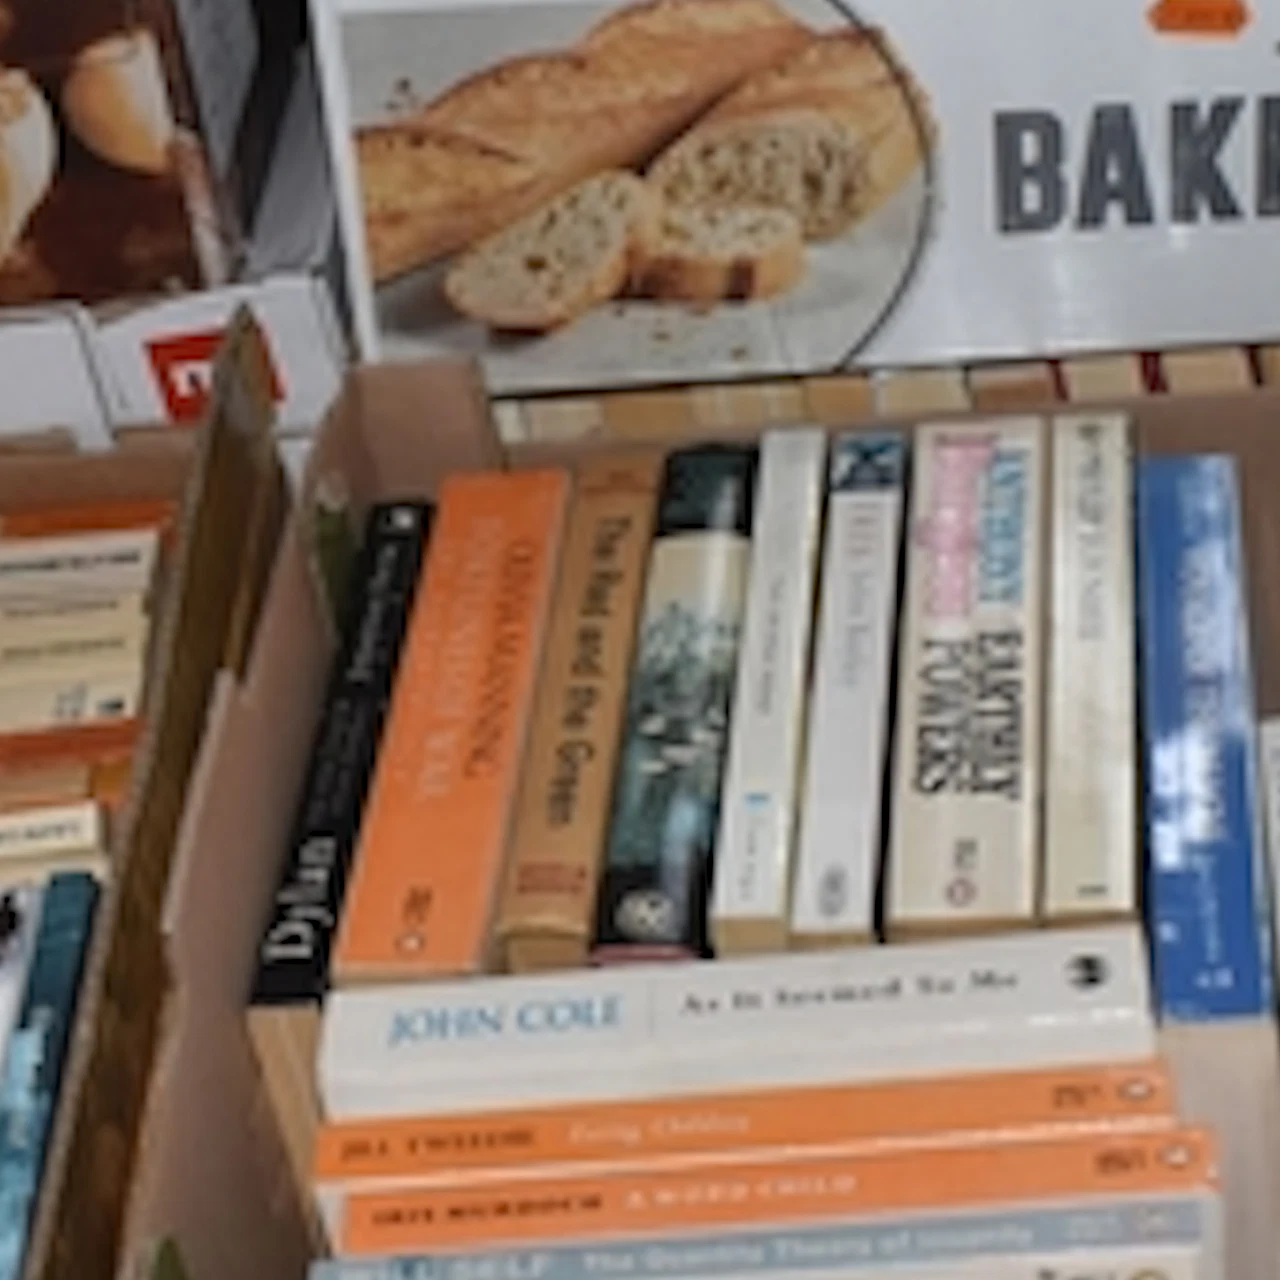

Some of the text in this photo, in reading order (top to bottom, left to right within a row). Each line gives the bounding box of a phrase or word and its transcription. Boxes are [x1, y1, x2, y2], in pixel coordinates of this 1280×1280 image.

[545, 514, 634, 827] The Red and the Green
[914, 636, 973, 797] POWERS
[969, 628, 1025, 802] EARTHLY
[260, 832, 340, 964] Dylan
[386, 994, 626, 1049] JOHN COLE
[678, 987, 721, 1018] As
[446, 1192, 606, 1224] MURDOCH
[775, 1233, 872, 1263] Theory
